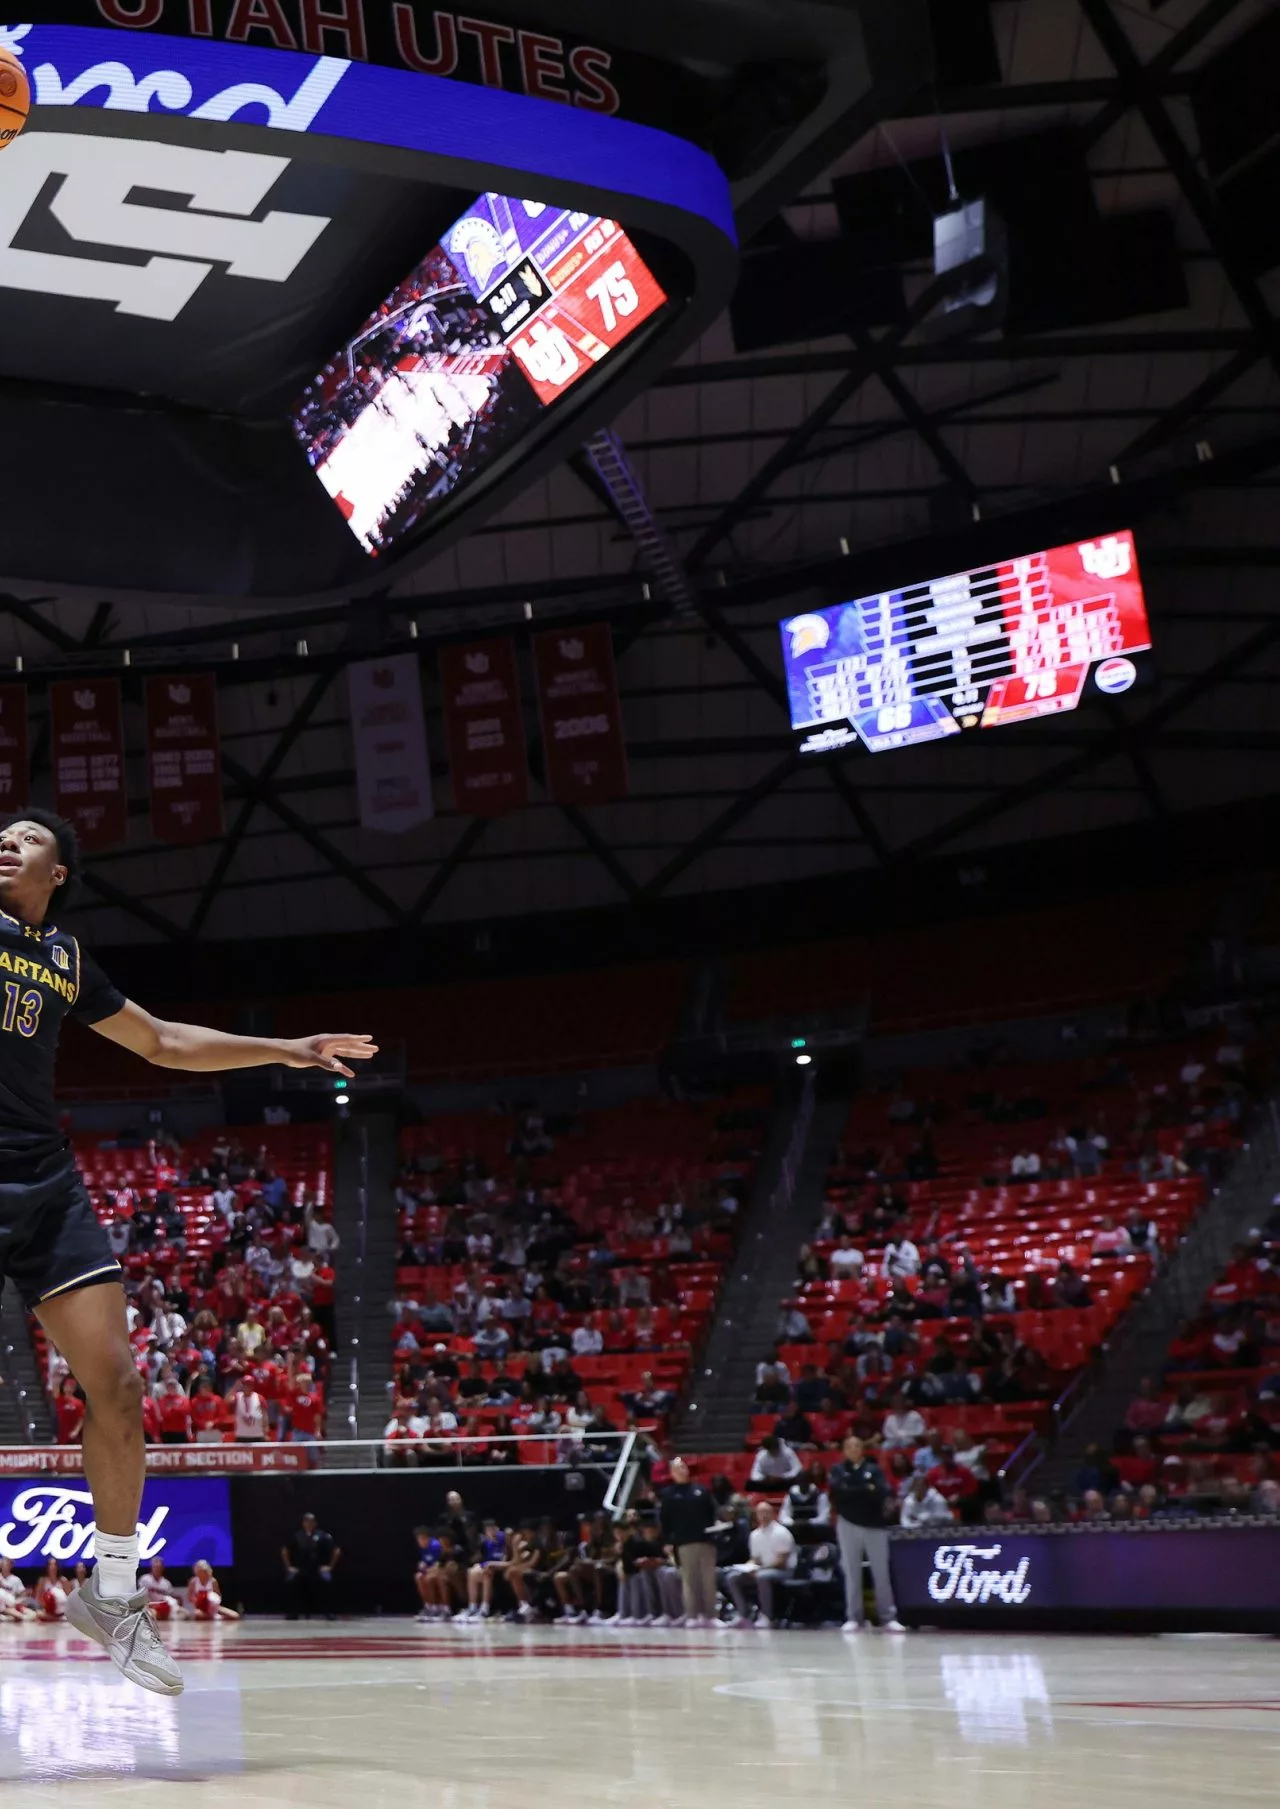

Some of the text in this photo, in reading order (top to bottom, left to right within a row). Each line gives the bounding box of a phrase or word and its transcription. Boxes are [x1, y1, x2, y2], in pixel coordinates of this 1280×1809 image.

[392, 2, 620, 115] UTES
[585, 260, 640, 332] 75
[2, 980, 44, 1038] 13
[0, 1453, 59, 1469] MIGHTY
[63, 1453, 83, 1468] UT
[185, 1451, 254, 1467] SECTION
[927, 1543, 1032, 1603] Ford
